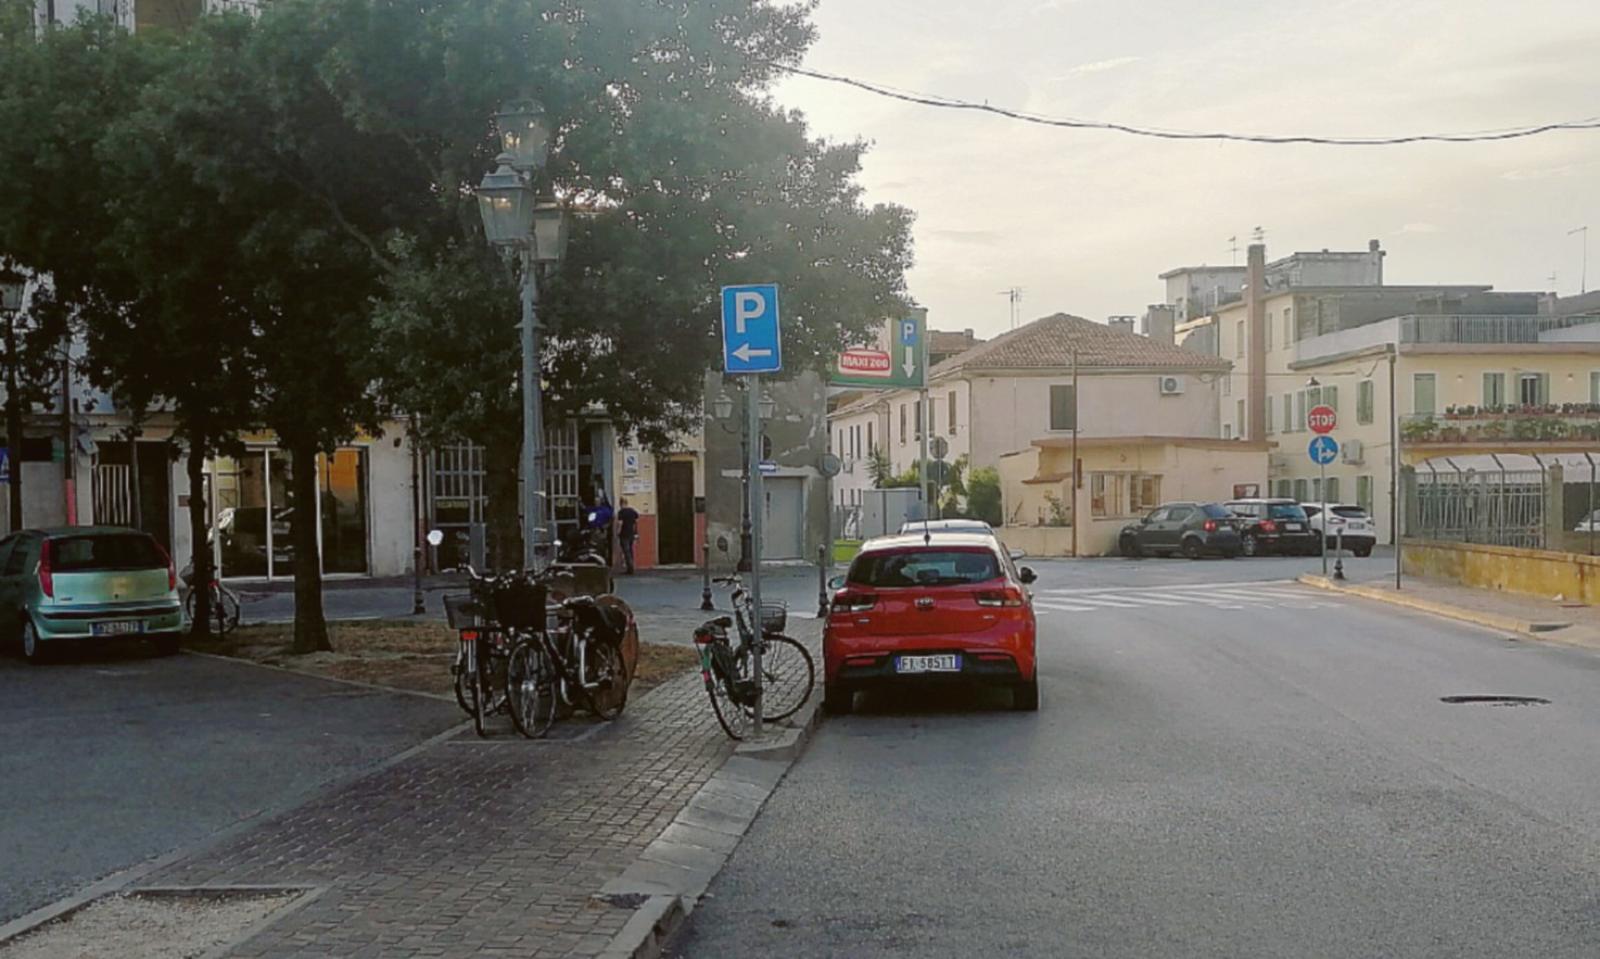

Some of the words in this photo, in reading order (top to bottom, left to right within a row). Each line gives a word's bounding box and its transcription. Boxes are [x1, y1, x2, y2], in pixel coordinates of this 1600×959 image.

[735, 291, 765, 333] P
[903, 322, 914, 340] P
[842, 355, 868, 368] MAXI
[869, 358, 889, 369] ZOO
[1309, 414, 1337, 427] STOP
